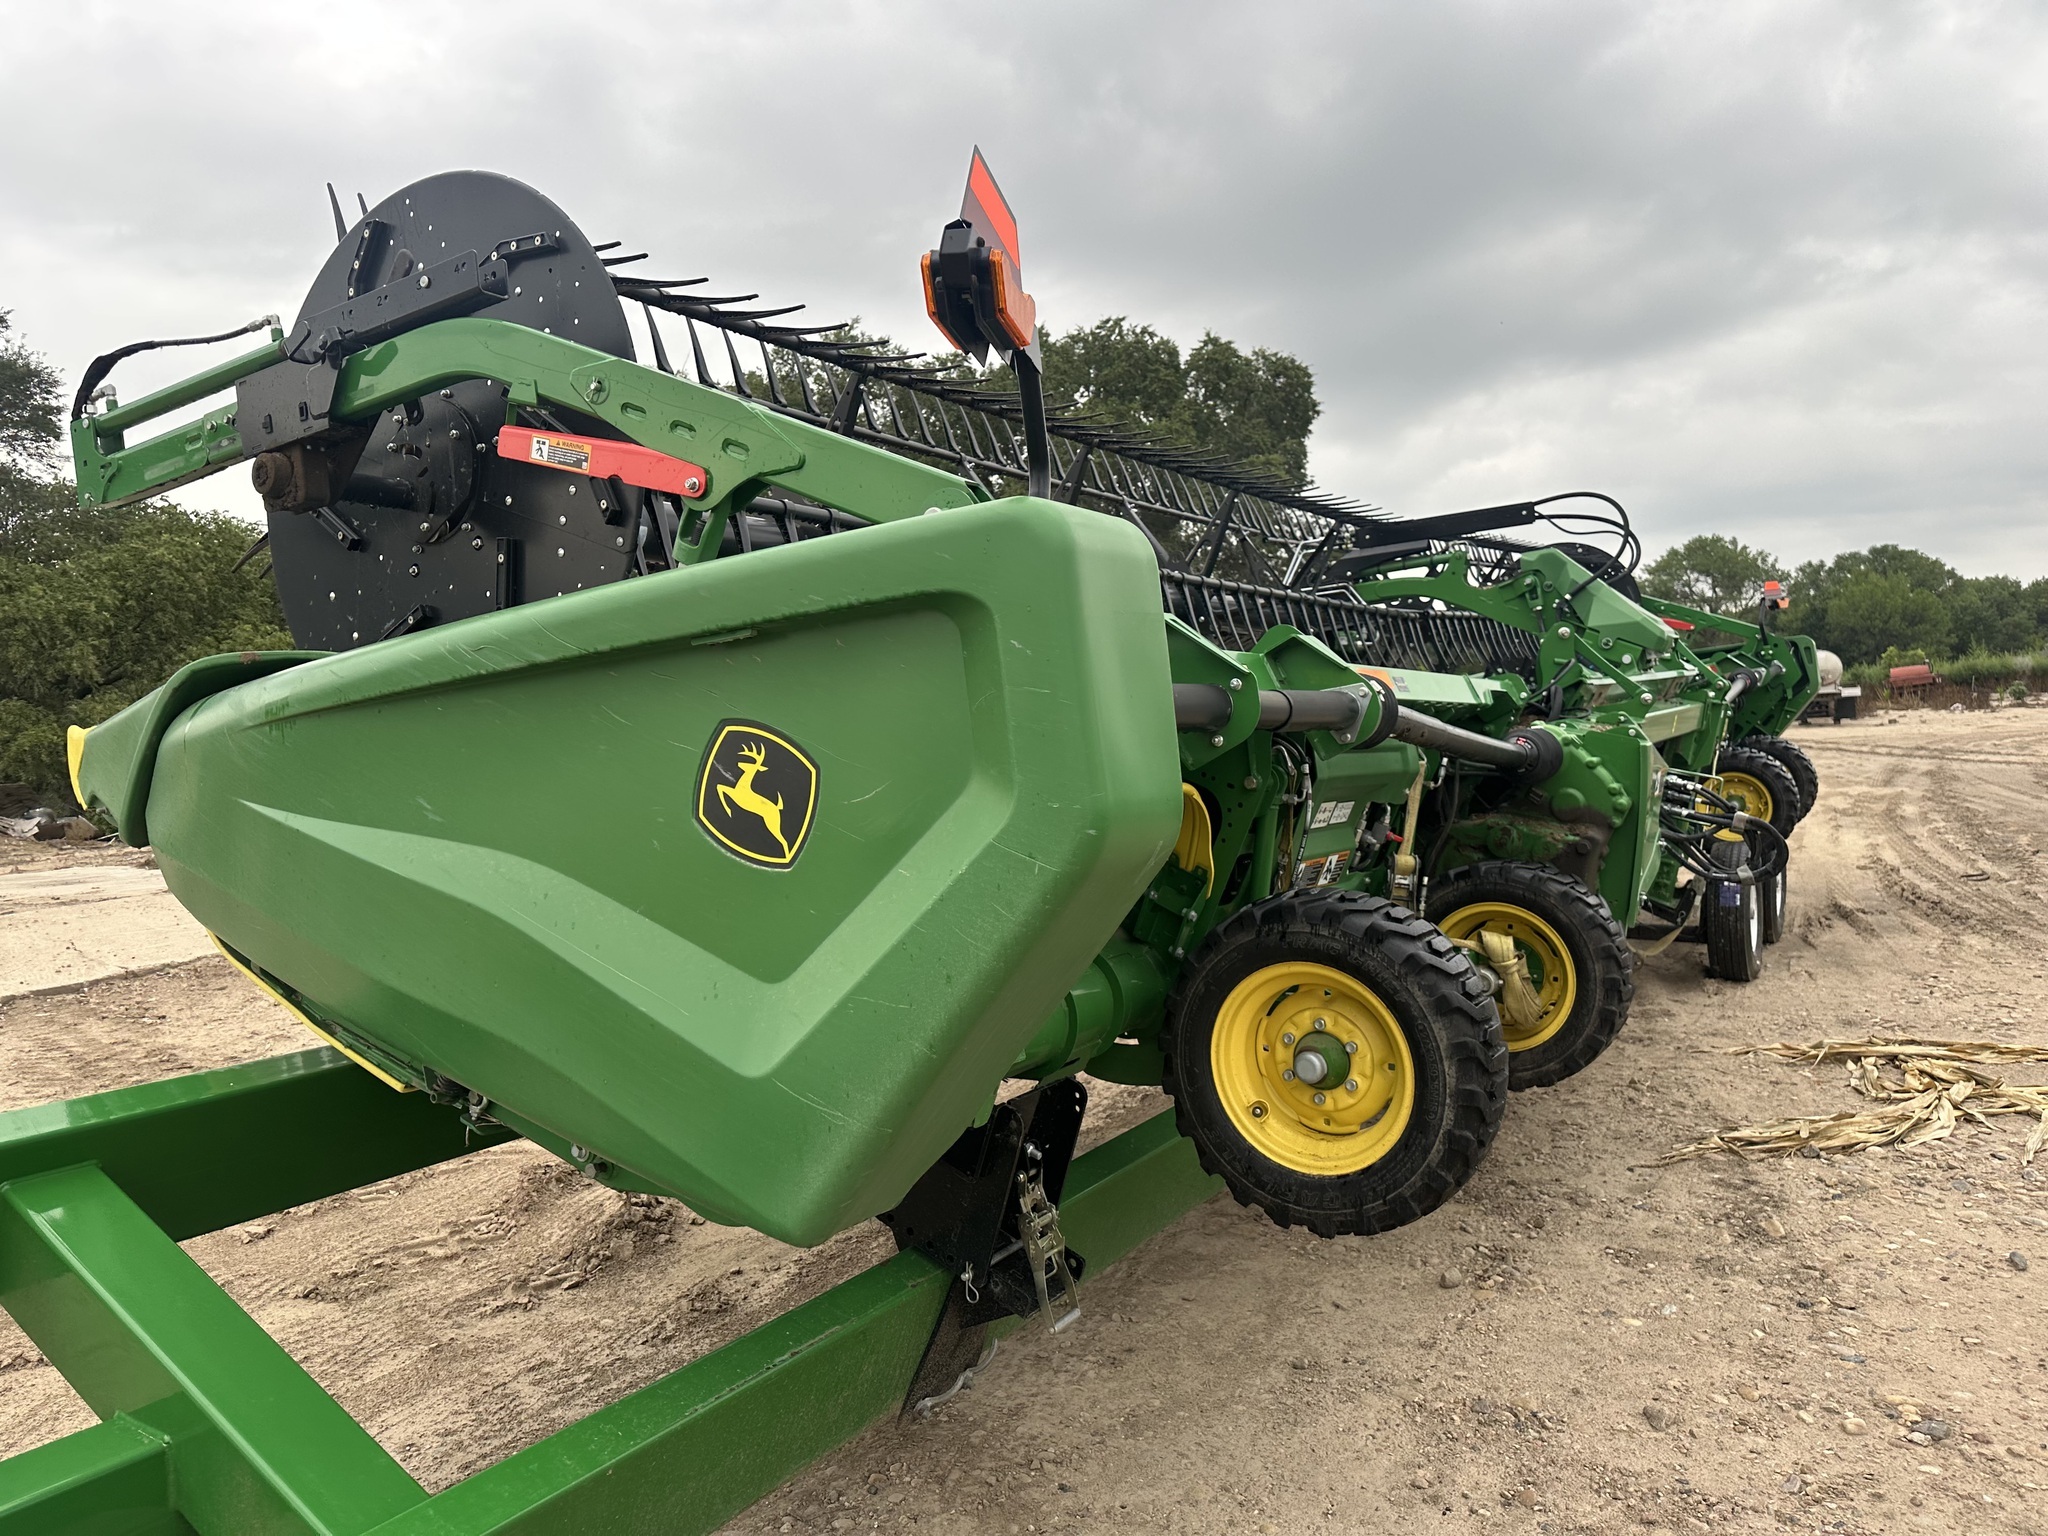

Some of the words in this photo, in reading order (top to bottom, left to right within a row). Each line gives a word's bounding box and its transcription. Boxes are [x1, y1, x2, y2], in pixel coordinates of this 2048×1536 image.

[376, 295, 383, 307] 2
[454, 263, 461, 275] 4
[562, 441, 584, 450] WARNING
